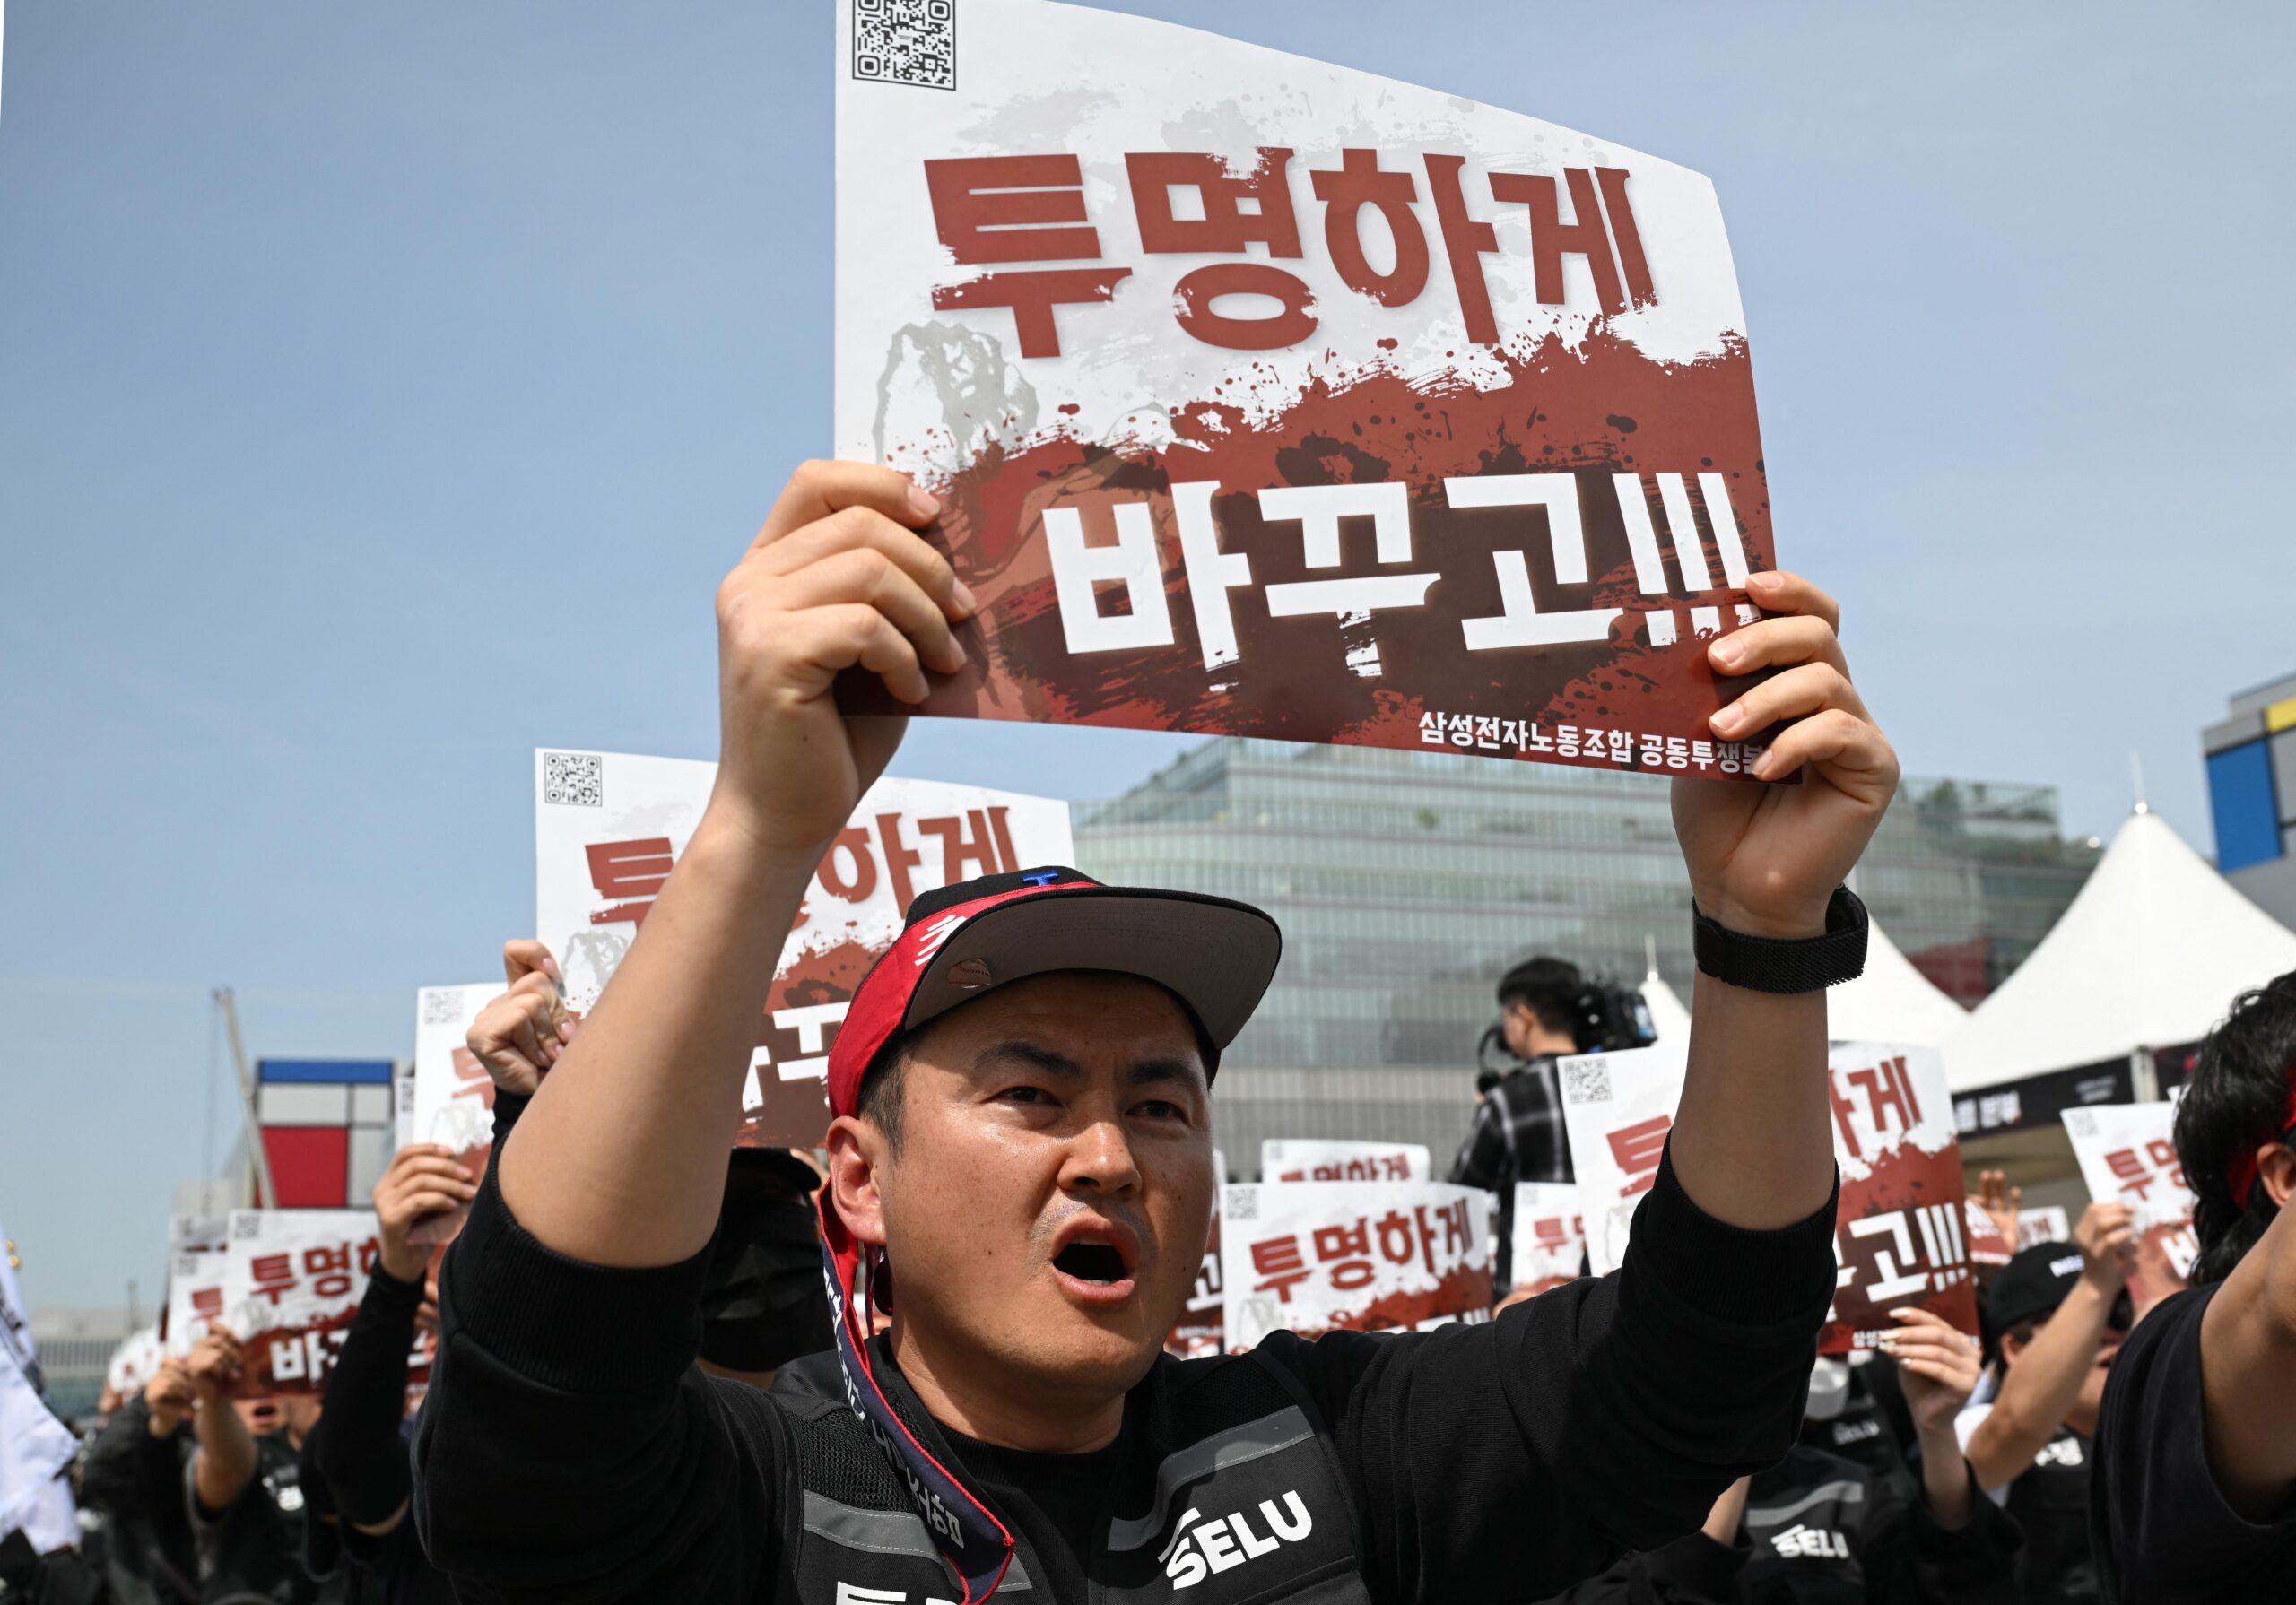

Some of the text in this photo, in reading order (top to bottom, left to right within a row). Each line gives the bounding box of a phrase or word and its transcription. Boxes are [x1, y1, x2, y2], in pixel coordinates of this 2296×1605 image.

[924, 147, 1659, 358] 투명하게
[1042, 472, 1760, 692] 바꾸고!!!
[1419, 711, 1634, 763] 삼성전자노동조합
[585, 806, 1020, 933] 투하게
[1250, 1197, 1474, 1304] 투명하게
[1158, 1490, 1313, 1591] SELU
